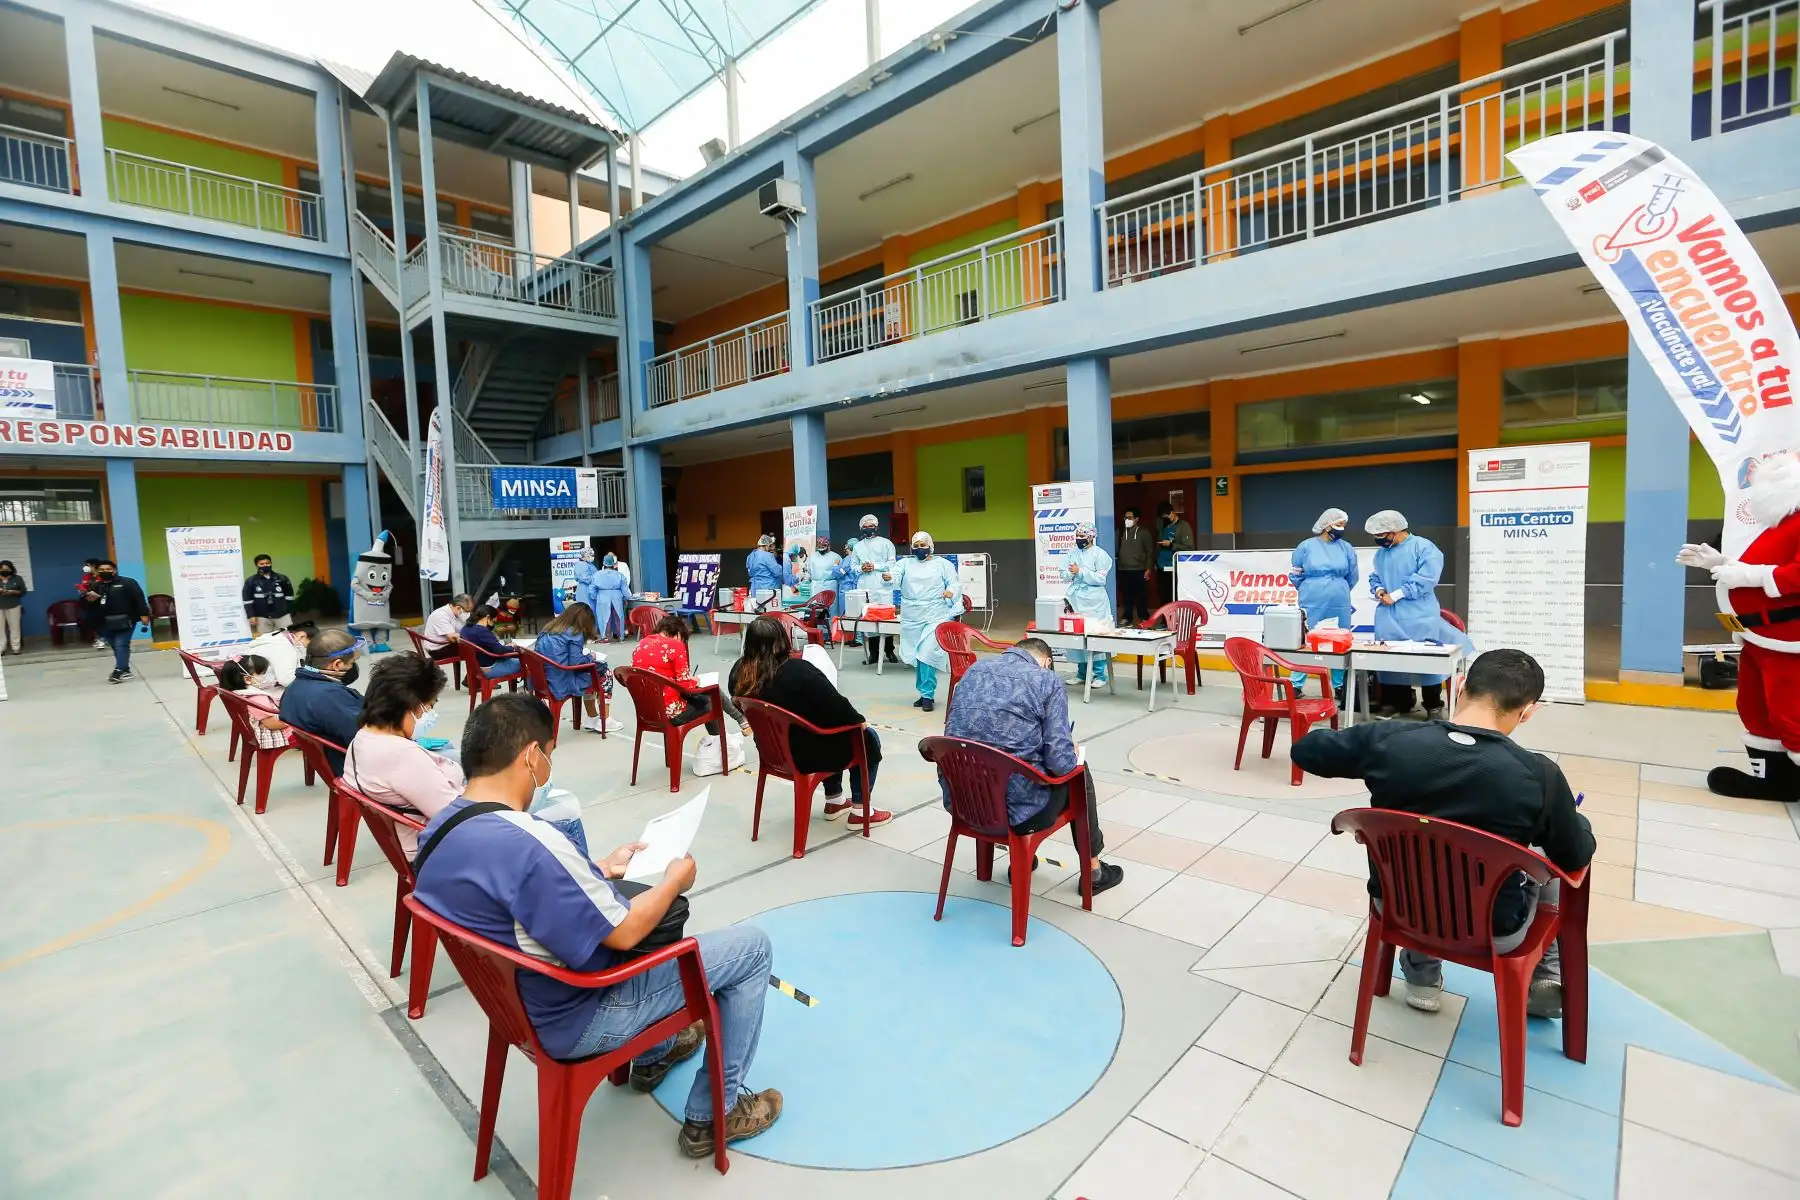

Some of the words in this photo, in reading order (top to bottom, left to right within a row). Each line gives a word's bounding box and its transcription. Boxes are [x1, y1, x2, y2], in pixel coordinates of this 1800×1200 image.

[1677, 214, 1765, 331] Vamos
[1645, 249, 1758, 417] encuentro
[1640, 299, 1695, 367] ¡Vacúnate
[1684, 359, 1715, 389] ya!
[1750, 338, 1778, 361] a
[8, 369, 28, 380] tu
[1757, 365, 1793, 409] tu
[0, 420, 292, 452] RESPONSABILIDAD
[501, 479, 571, 497] MINSA
[1482, 514, 1516, 526] Lima
[1520, 513, 1572, 525] Centro
[184, 537, 216, 545] Vamos
[1503, 528, 1548, 539] MINSA
[556, 561, 575, 569] CENTR
[1233, 589, 1298, 604] encue
